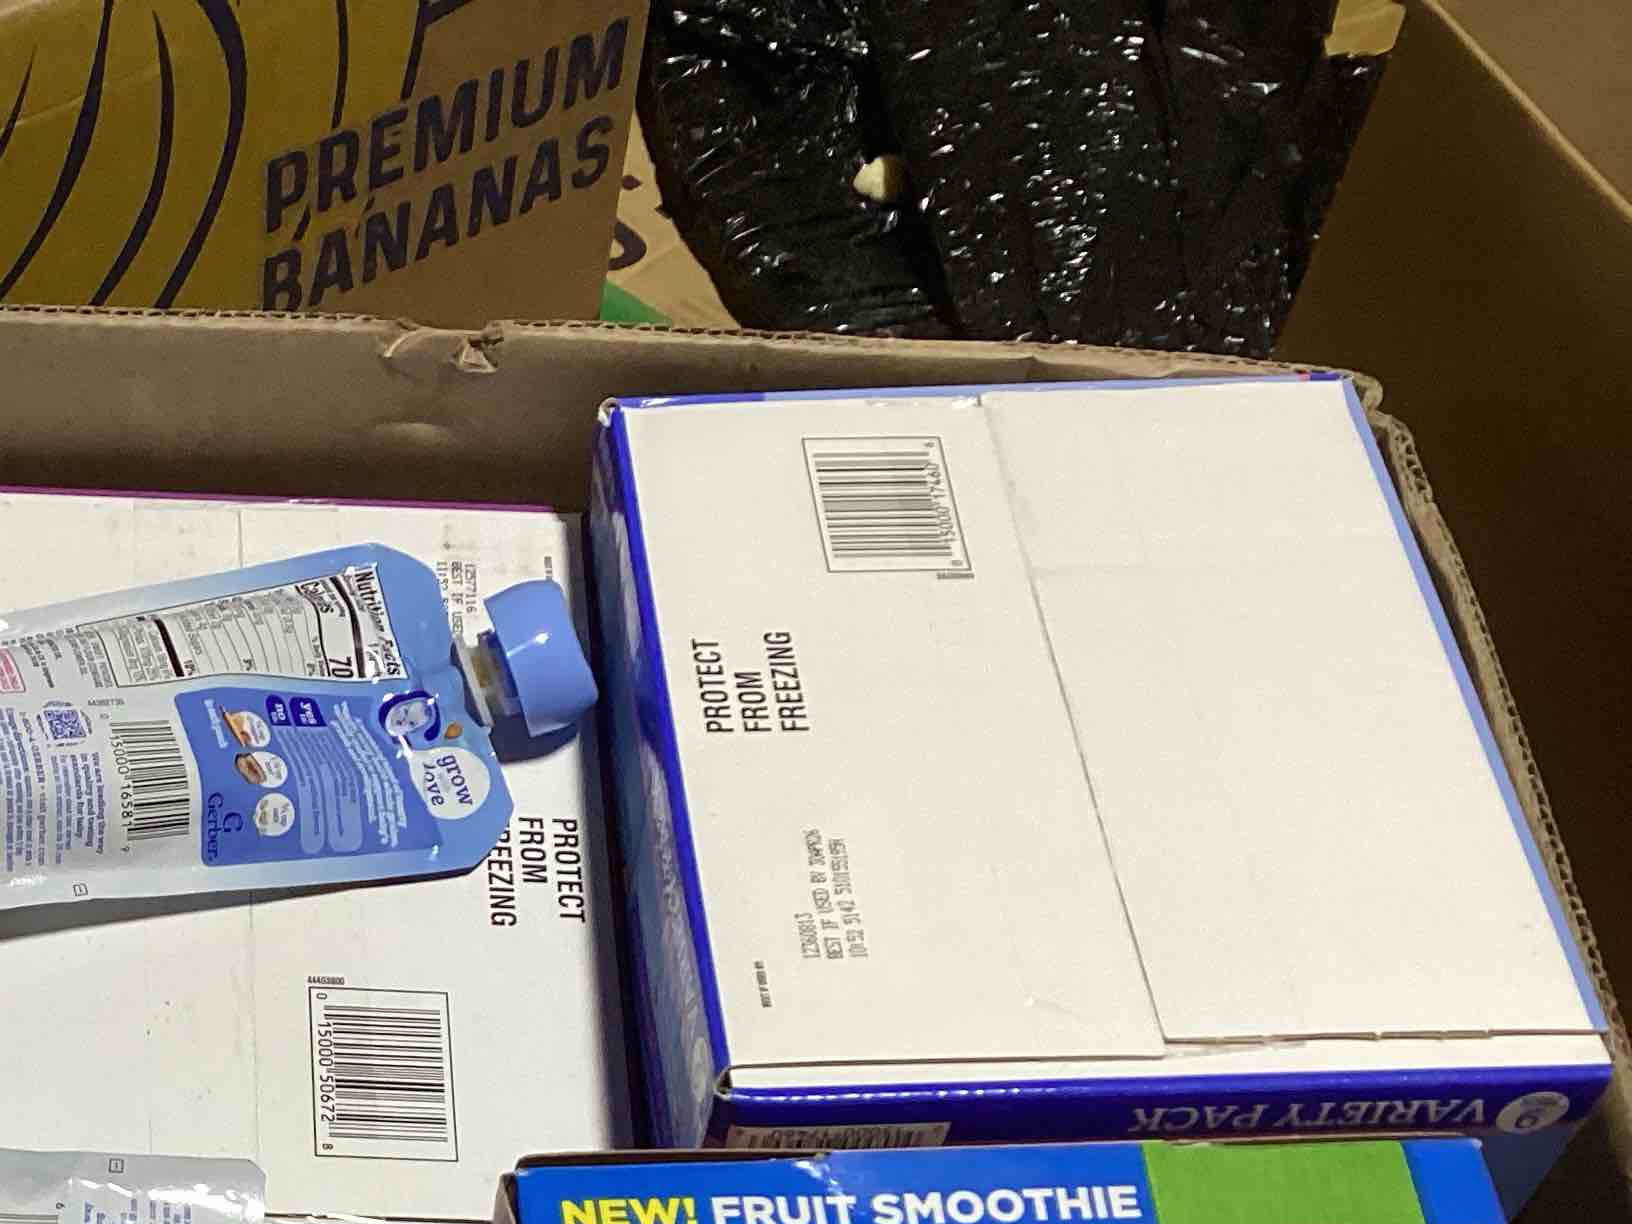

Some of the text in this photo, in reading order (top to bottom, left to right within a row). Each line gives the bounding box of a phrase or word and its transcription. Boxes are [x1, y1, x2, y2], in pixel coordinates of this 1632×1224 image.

[264, 16, 628, 234] PREMIUM
[262, 115, 614, 311] BANANAS
[354, 570, 386, 632] Nutrition
[451, 561, 463, 605] BEST IF
[328, 656, 354, 679] 70
[691, 638, 735, 733] PROTECT
[763, 631, 809, 732] FREEZING
[276, 704, 286, 721] no
[303, 702, 318, 725] yes
[734, 671, 773, 733] FROM
[110, 735, 133, 828] 15000 16581
[436, 754, 473, 806] grow
[206, 791, 226, 857] Gerber
[518, 817, 548, 884] FROM
[551, 818, 586, 924] PROTECT
[317, 1021, 336, 1122] 15000 50672
[1127, 1103, 1270, 1133] PACK
[1274, 1098, 1487, 1129] VARIETY
